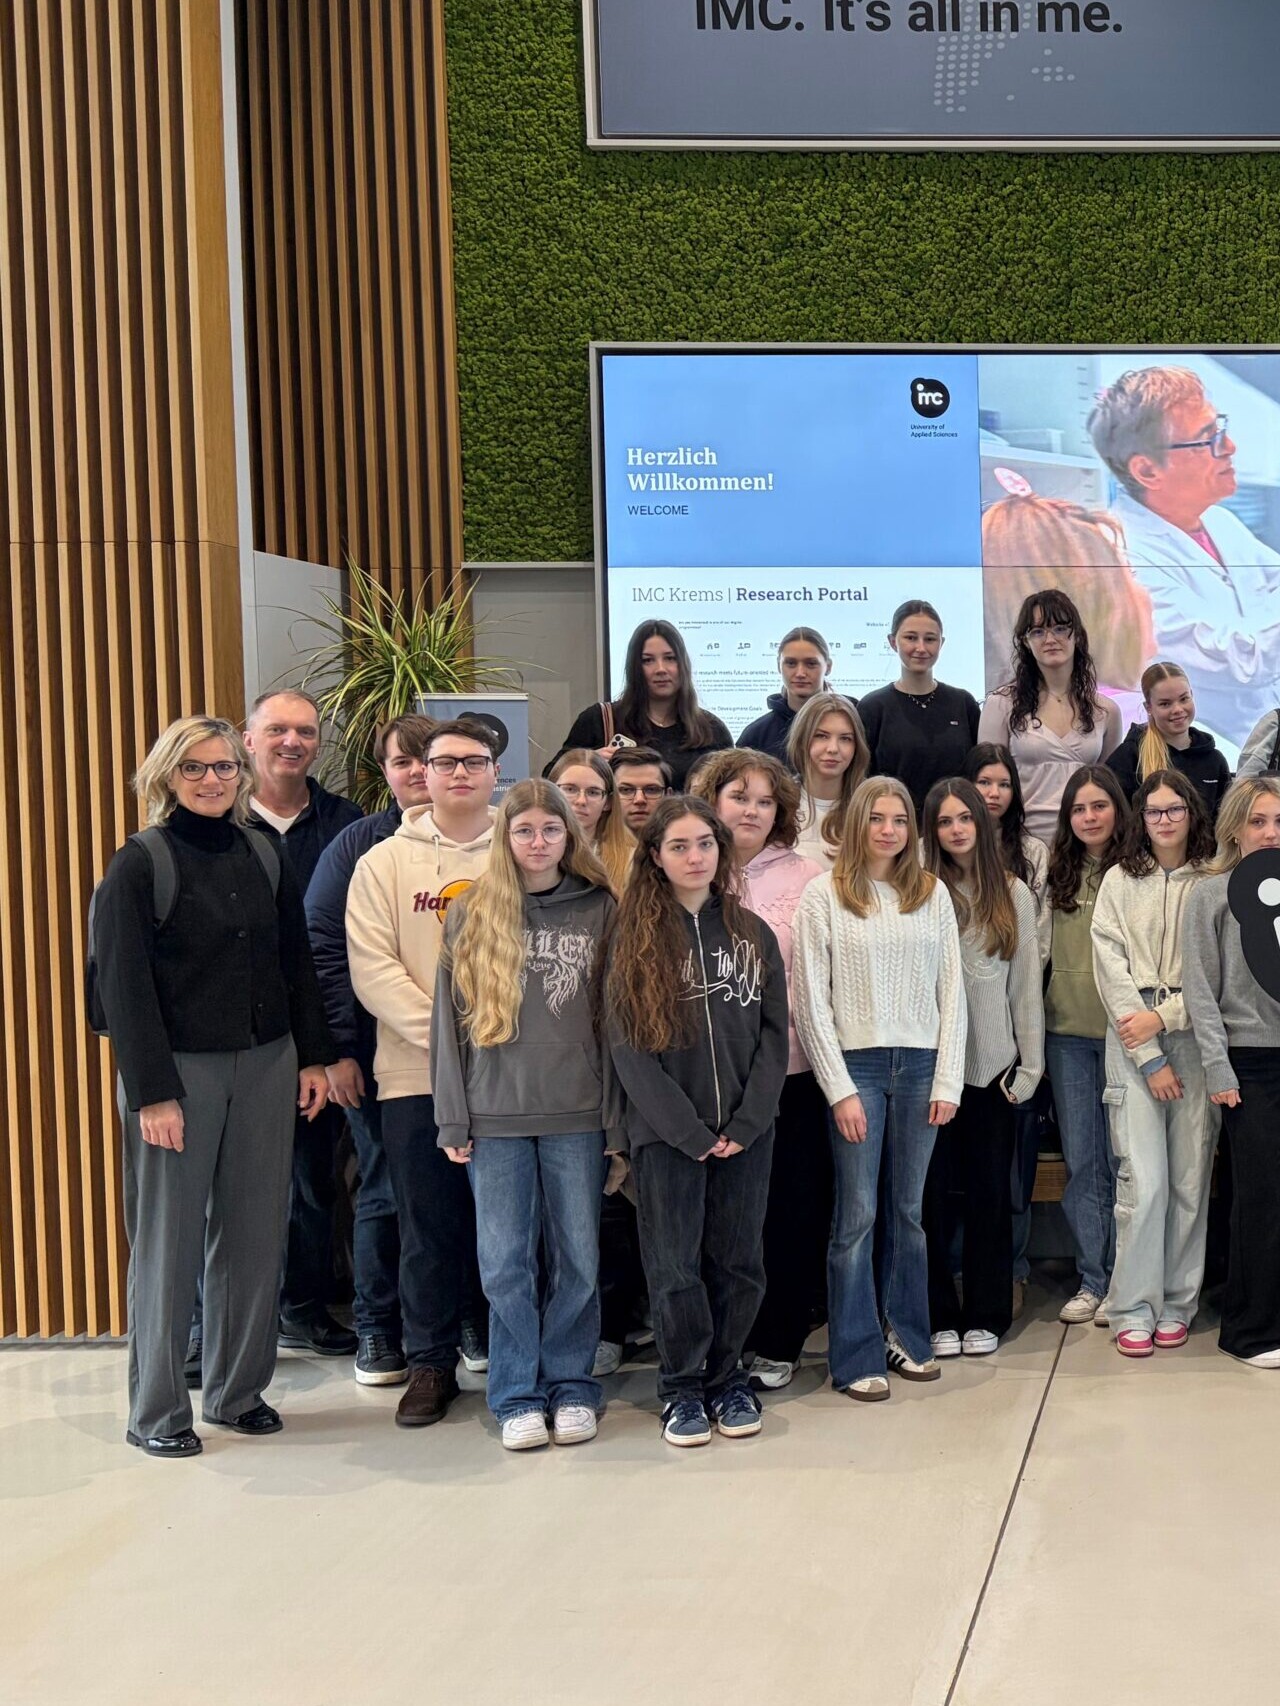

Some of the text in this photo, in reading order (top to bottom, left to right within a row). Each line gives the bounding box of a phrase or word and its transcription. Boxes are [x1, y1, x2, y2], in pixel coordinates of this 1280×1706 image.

[696, 0, 1123, 34] IMC. Its all in me.
[916, 383, 944, 405] imc
[627, 447, 718, 466] Herzlich
[626, 472, 774, 491] Willkommen!
[627, 505, 689, 516] WELCOME
[632, 587, 665, 602] IMC
[669, 587, 723, 602] Krems
[736, 587, 814, 602] Research
[817, 587, 869, 602] Portal
[413, 891, 452, 913] Har
